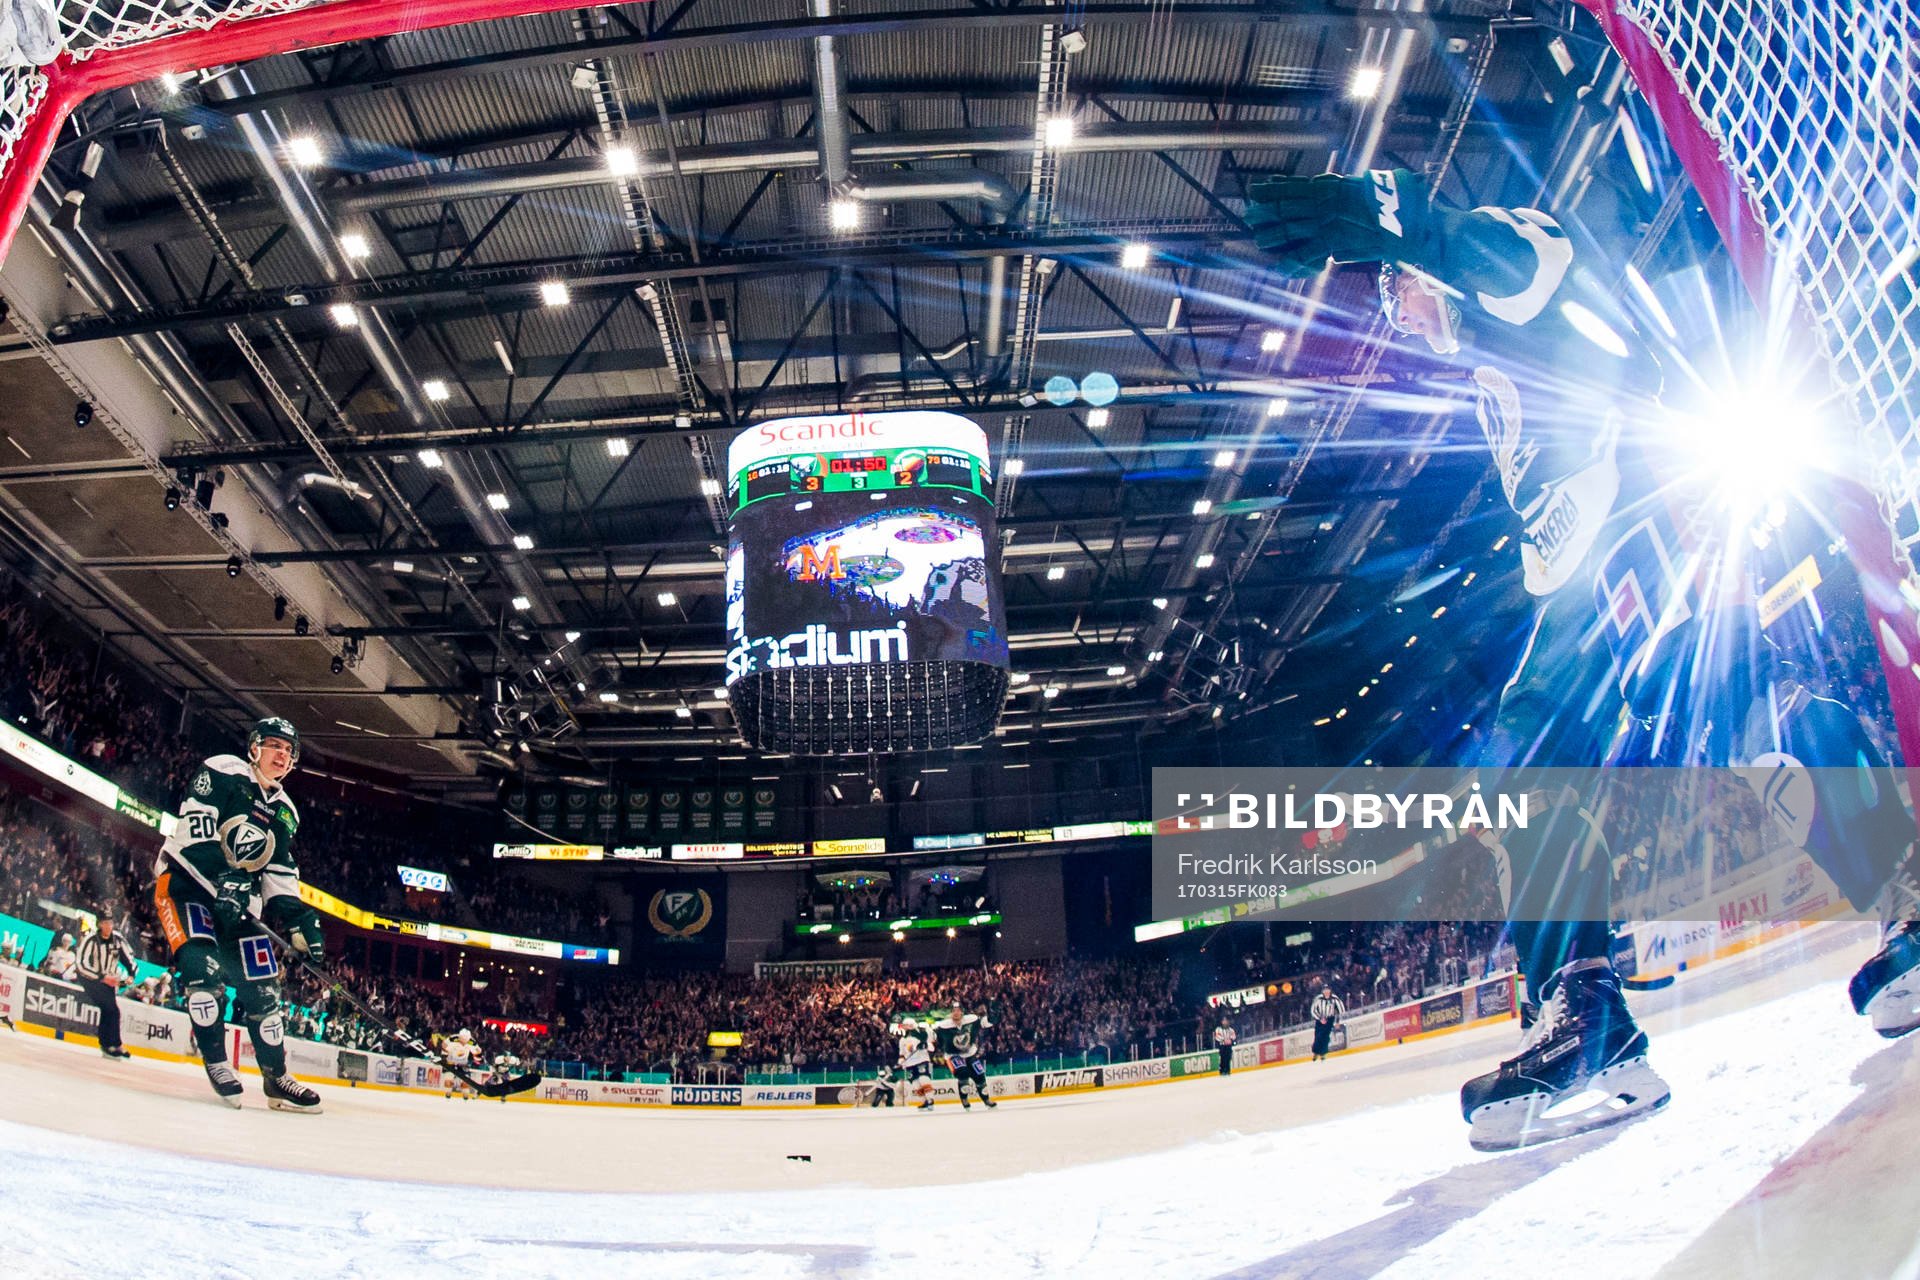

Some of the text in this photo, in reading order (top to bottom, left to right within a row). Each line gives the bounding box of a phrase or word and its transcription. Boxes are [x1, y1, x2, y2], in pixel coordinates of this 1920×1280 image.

[759, 412, 884, 446] Scandic
[830, 457, 887, 473] 01:50
[806, 477, 818, 490] 3
[854, 478, 865, 489] 3
[901, 472, 913, 485] 2
[799, 544, 847, 581] M
[189, 816, 215, 839] 20
[614, 846, 662, 858] stadium
[1718, 892, 1769, 930] MAXI
[24, 986, 101, 1027] stadium
[416, 1066, 441, 1086] ELON
[1105, 1062, 1168, 1082] SKARINGS
[672, 1086, 742, 1103] HÖJDENS
[756, 1091, 813, 1101] REJLERS
